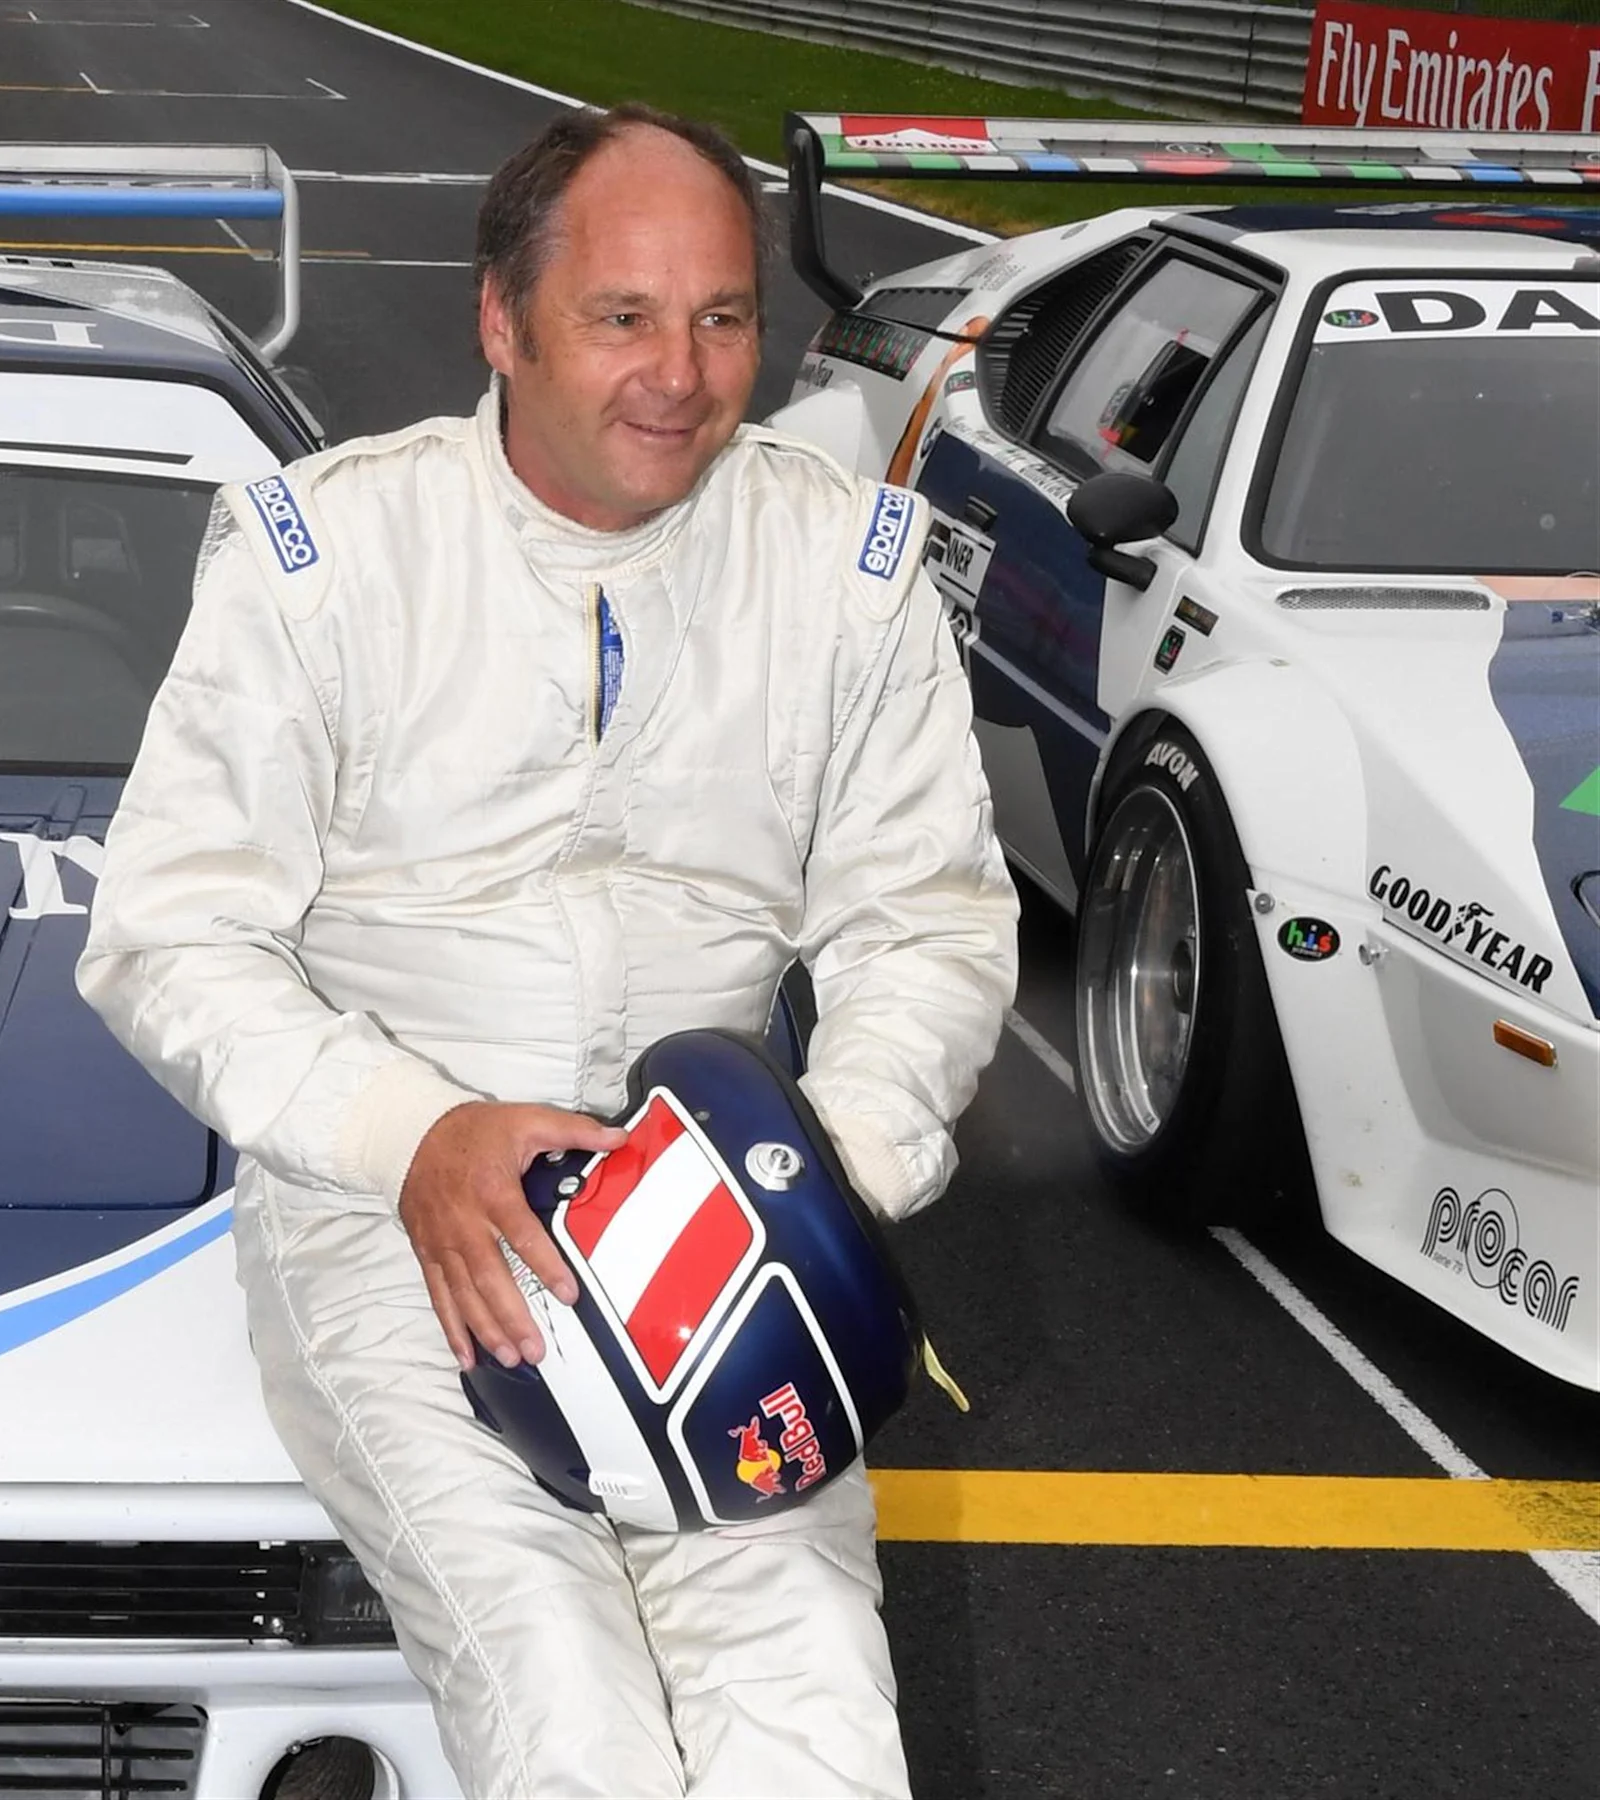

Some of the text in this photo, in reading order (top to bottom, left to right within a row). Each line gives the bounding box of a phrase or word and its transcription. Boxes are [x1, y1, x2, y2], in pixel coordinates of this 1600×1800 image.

[1318, 21, 1376, 128] Fly
[1381, 29, 1554, 132] Emirates
[1144, 742, 1199, 791] AVON
